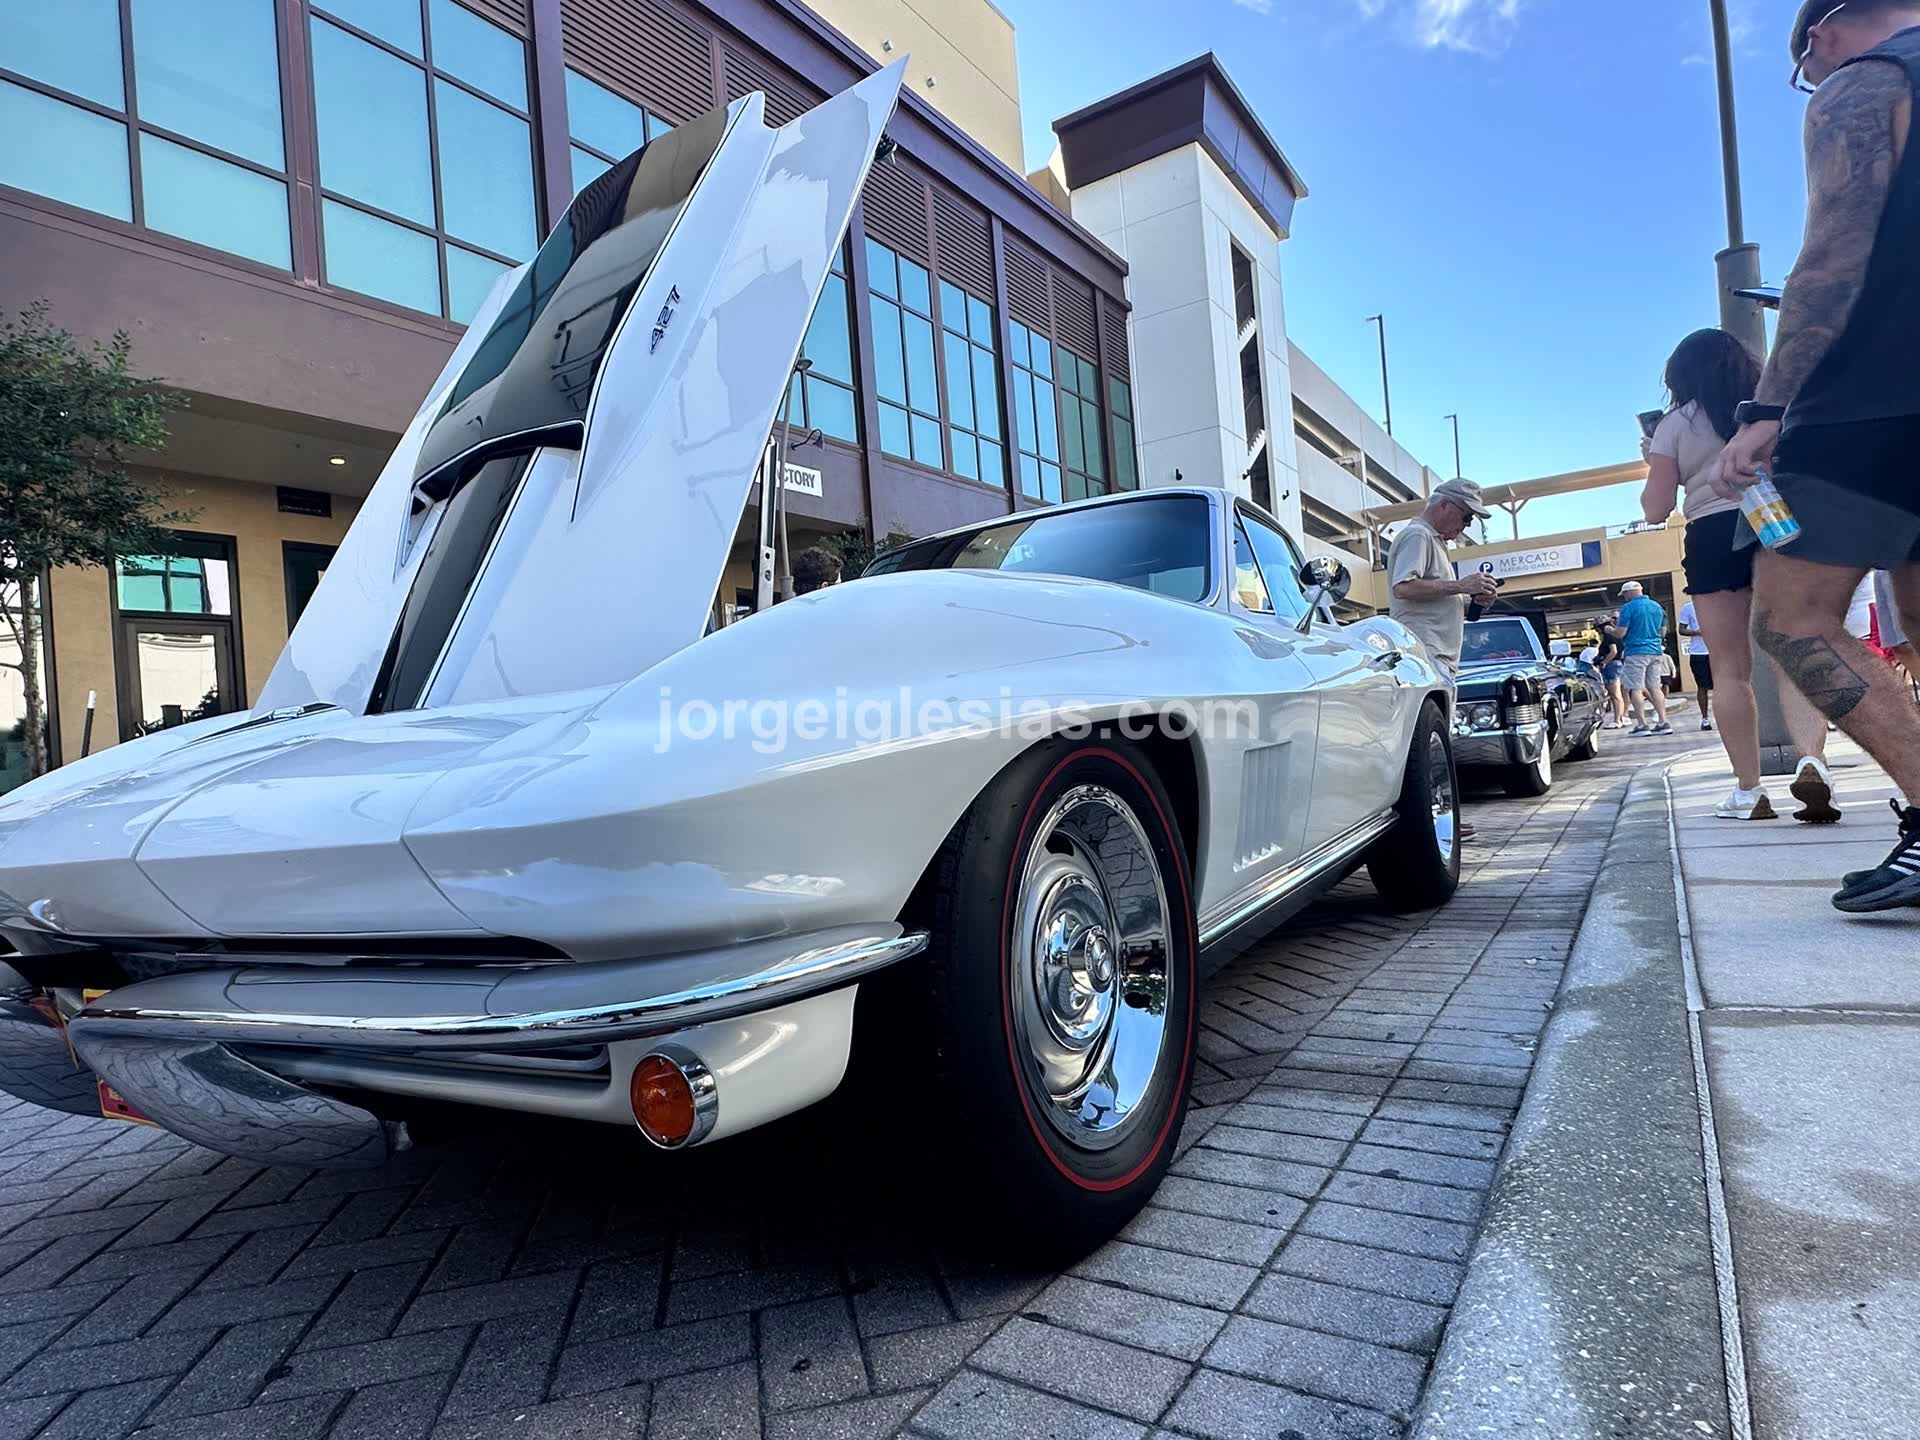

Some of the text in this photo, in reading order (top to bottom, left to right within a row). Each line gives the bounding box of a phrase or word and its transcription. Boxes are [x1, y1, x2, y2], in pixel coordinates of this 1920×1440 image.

[650, 284, 680, 354] 427
[778, 467, 816, 489] CTORY
[1500, 551, 1559, 567] MERCATO
[1530, 560, 1560, 570] GARAGE
[1483, 563, 1490, 573] P
